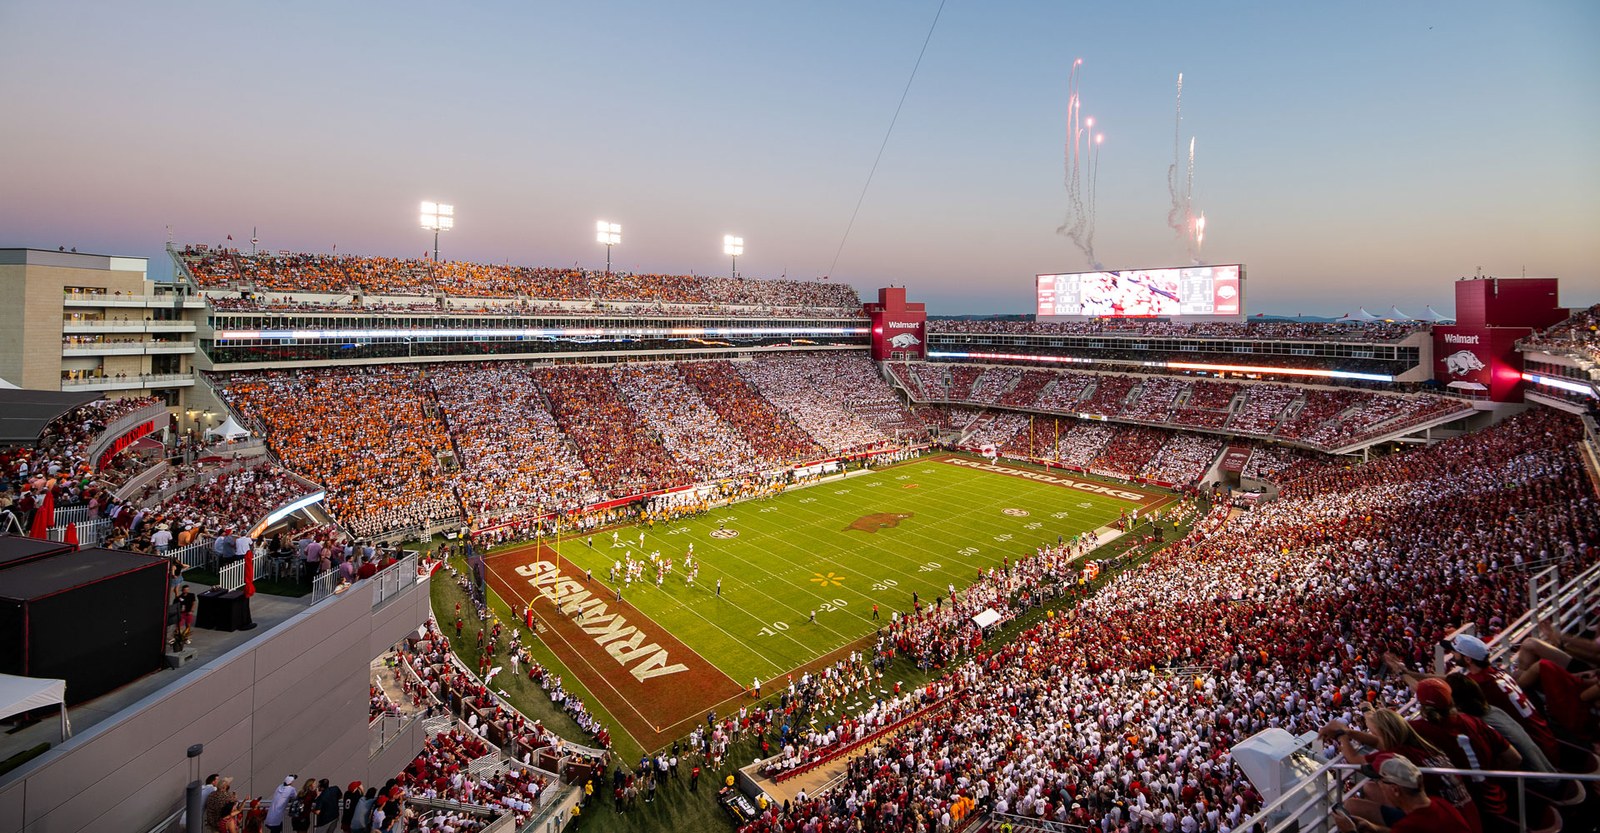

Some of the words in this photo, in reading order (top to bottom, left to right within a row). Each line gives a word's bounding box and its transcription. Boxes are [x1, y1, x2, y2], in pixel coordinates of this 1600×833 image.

[888, 321, 919, 329] Walmart
[1444, 333, 1479, 344] Walmart
[944, 458, 1144, 501] RAZORBACKS
[957, 546, 980, 557] 50
[919, 561, 942, 572] 40
[872, 578, 898, 591] 30
[820, 598, 848, 613] 20
[514, 560, 690, 683] ARKANSAS
[760, 621, 789, 637] 10
